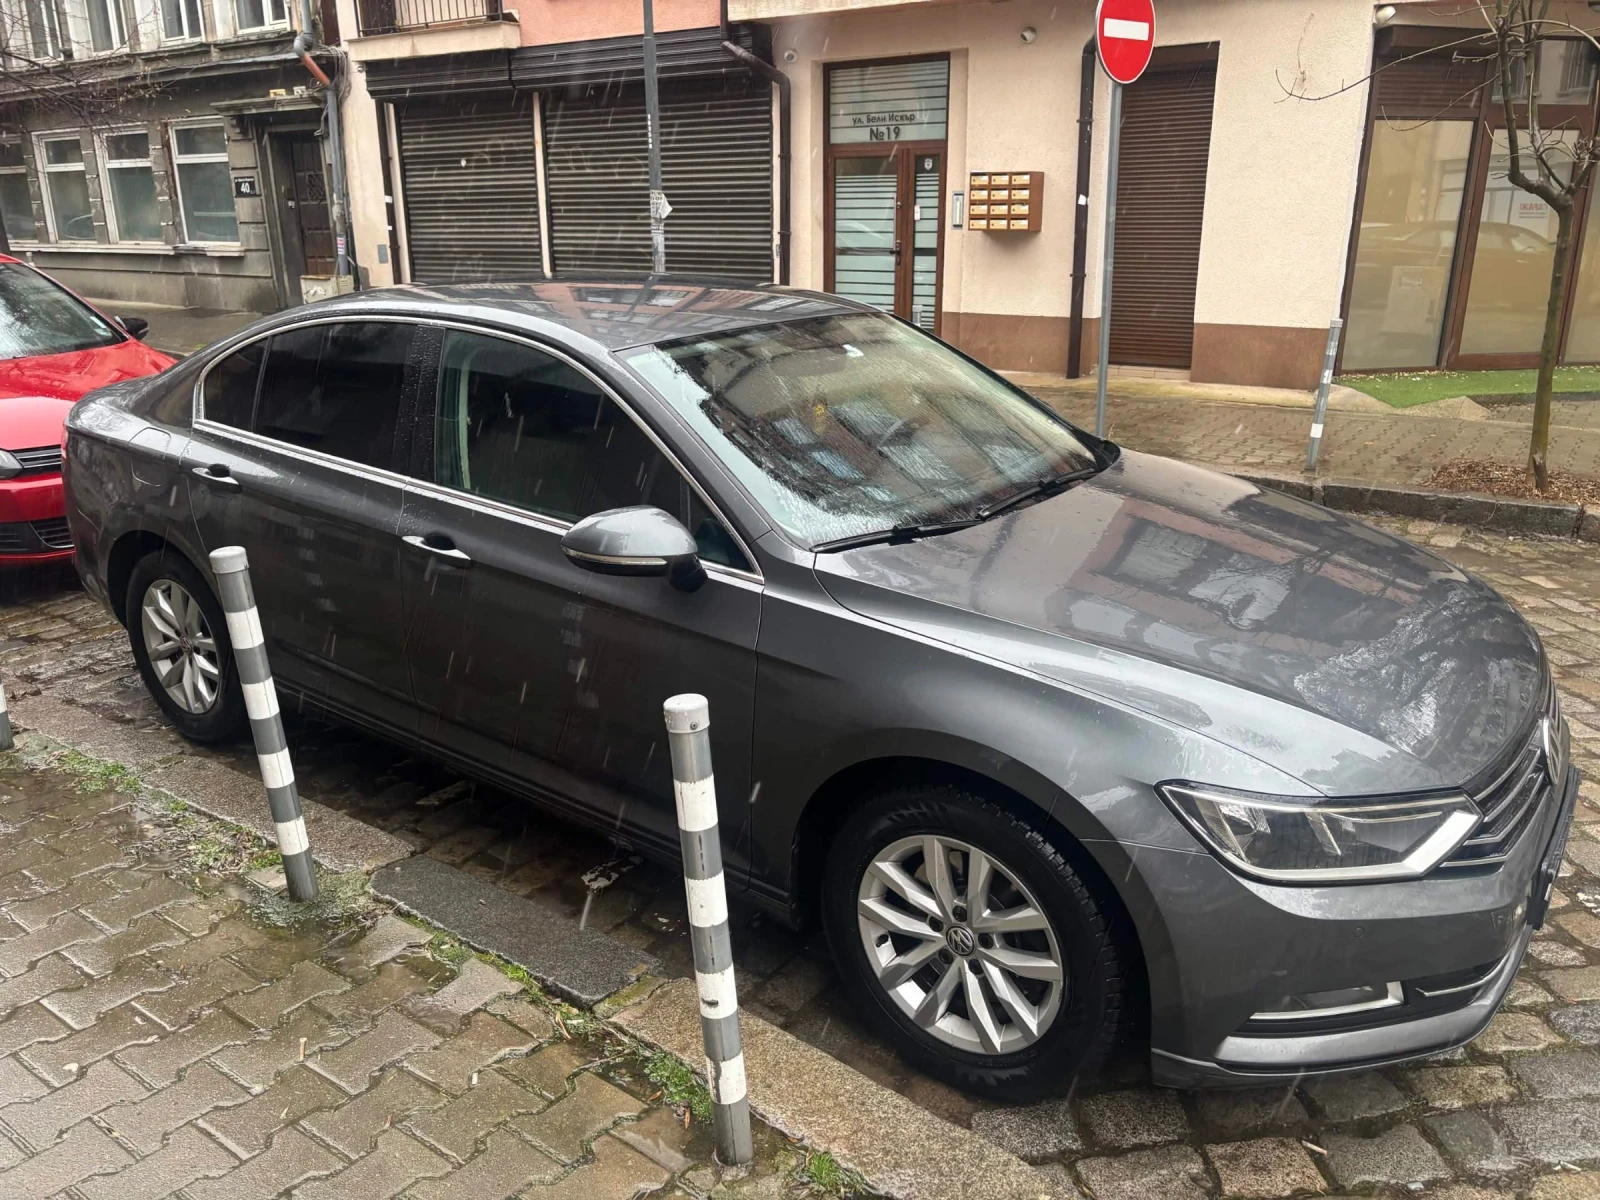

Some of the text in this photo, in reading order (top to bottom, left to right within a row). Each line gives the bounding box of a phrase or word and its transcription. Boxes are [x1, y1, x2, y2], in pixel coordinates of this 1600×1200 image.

[852, 116, 864, 126] ул.
[888, 113, 915, 122] Искър
[240, 182, 250, 193] 40
